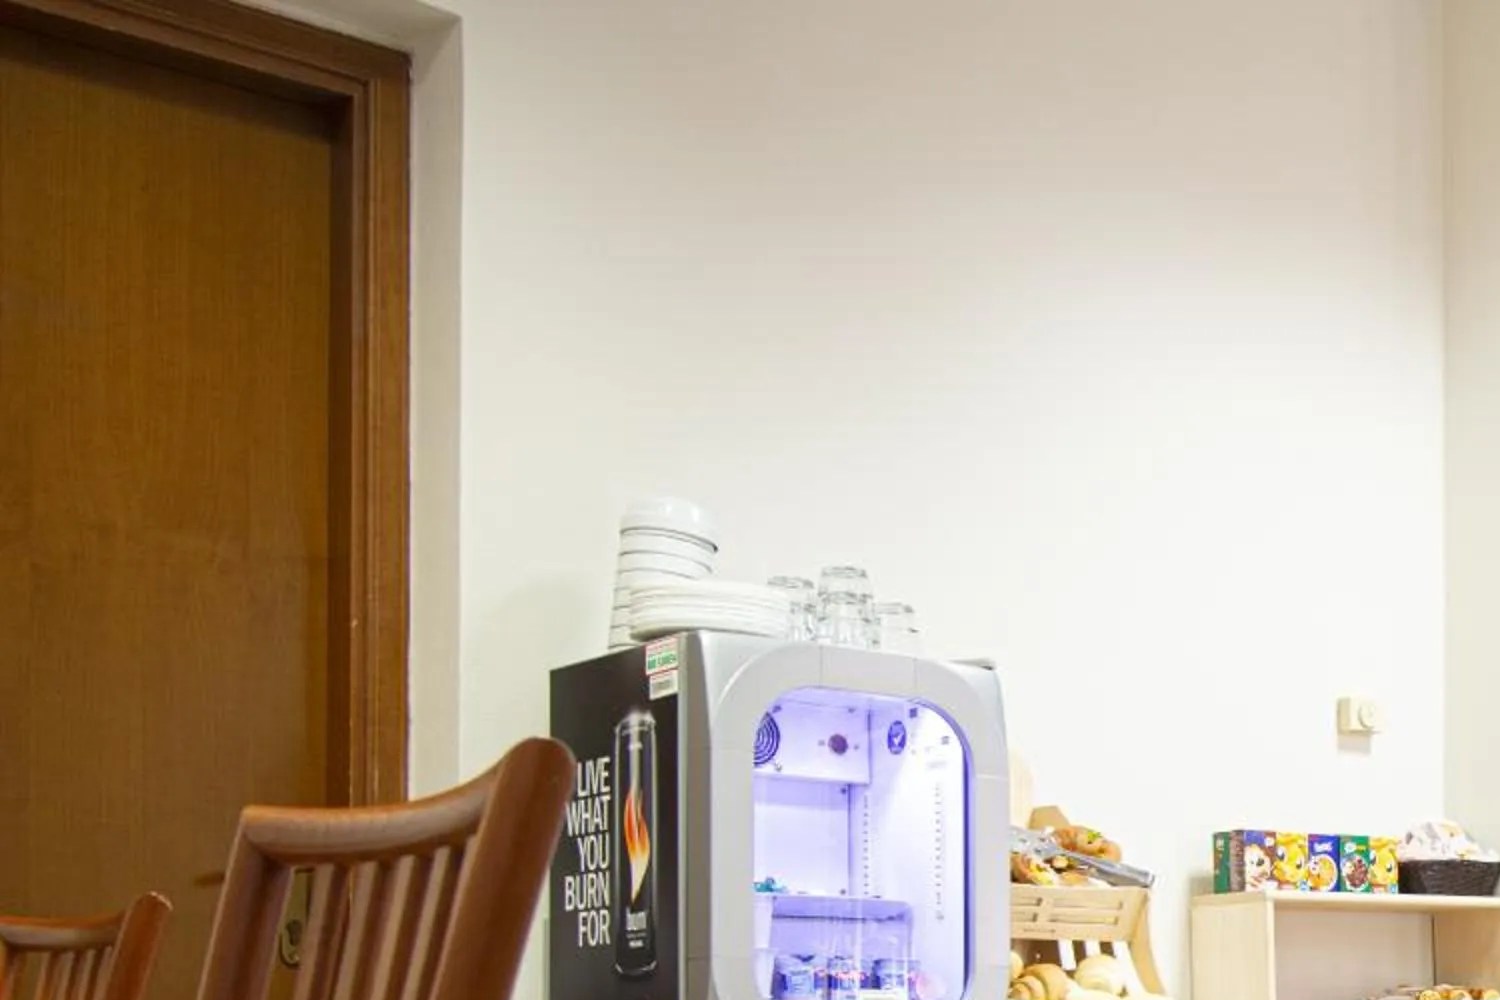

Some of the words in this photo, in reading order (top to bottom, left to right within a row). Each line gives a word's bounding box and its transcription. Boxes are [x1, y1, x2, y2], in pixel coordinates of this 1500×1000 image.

[577, 756, 611, 797] LIVE
[566, 795, 611, 837] WHAT
[577, 832, 610, 872] YOU
[564, 871, 610, 912] BURN
[577, 909, 611, 948] FOR
